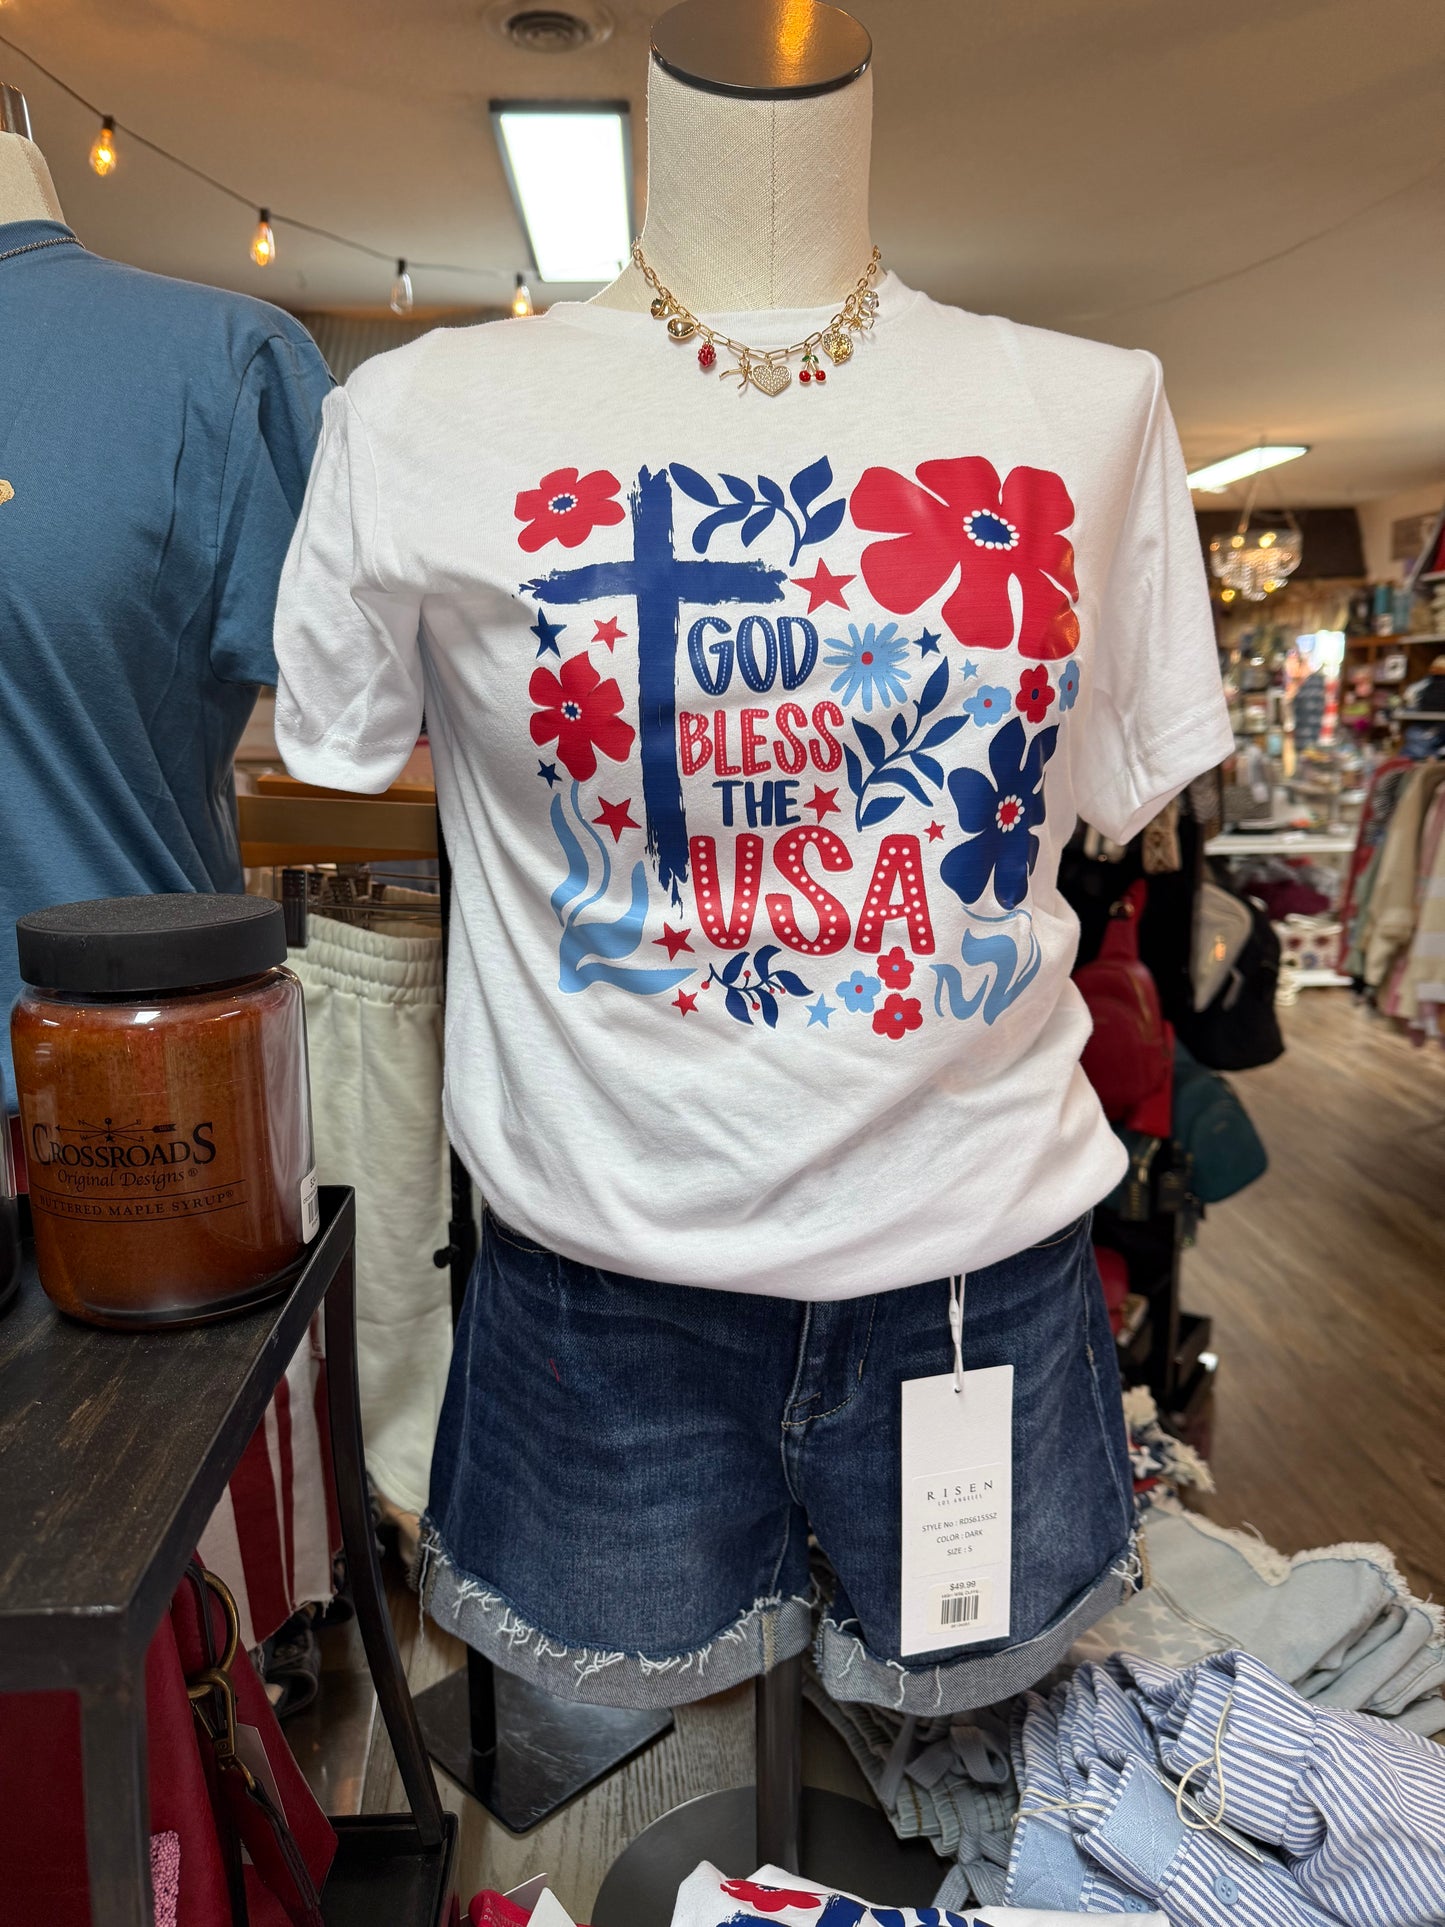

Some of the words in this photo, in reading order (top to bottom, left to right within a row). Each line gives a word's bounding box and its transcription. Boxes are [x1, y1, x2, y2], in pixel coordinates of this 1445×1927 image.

[687, 615, 819, 696] GOD
[679, 701, 844, 777] BLESS
[712, 780, 801, 828] THE
[689, 825, 936, 956] USA
[57, 1168, 118, 1192] Original
[109, 1203, 166, 1216] MAPLE
[927, 1480, 993, 1501] RISEN
[921, 1522, 942, 1533] STYLE
[936, 1533, 960, 1544] COLOR
[964, 1529, 984, 1539] DARK
[946, 1547, 962, 1556] SIZE
[967, 1545, 973, 1553] S
[950, 1580, 976, 1591] $49.99
